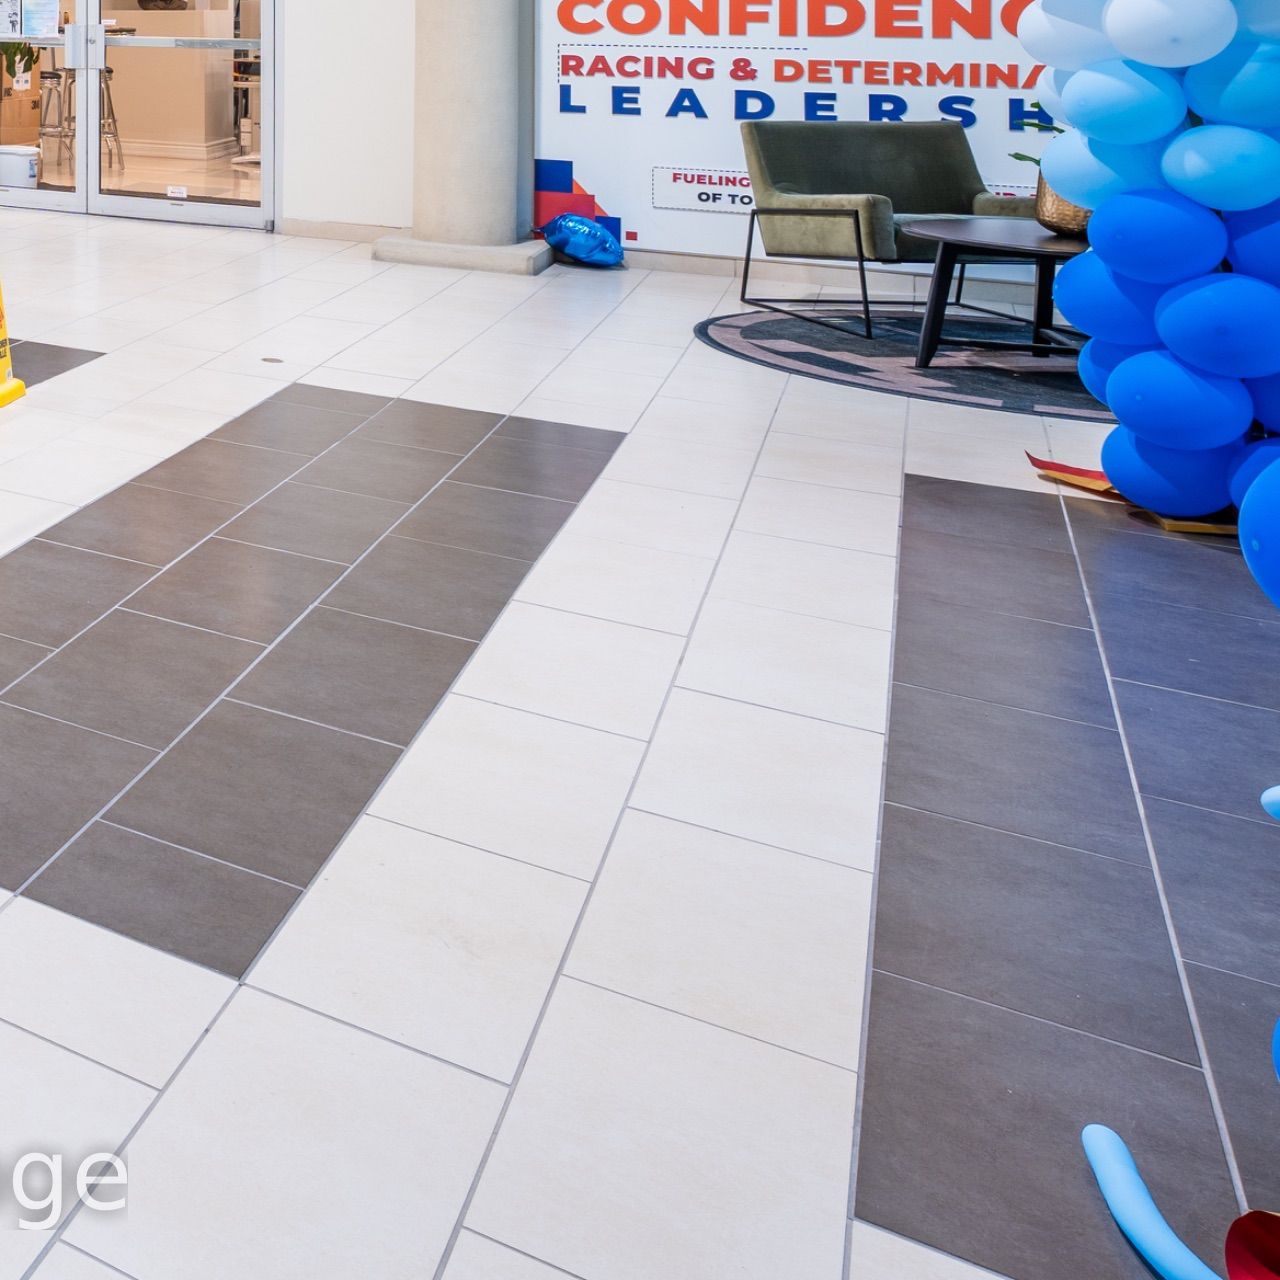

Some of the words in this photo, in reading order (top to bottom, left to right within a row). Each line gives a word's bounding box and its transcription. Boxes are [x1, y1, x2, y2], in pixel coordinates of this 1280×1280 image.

[561, 54, 715, 80] RACING
[729, 57, 757, 81] &
[672, 172, 751, 188] FUELING
[697, 191, 722, 203] OF
